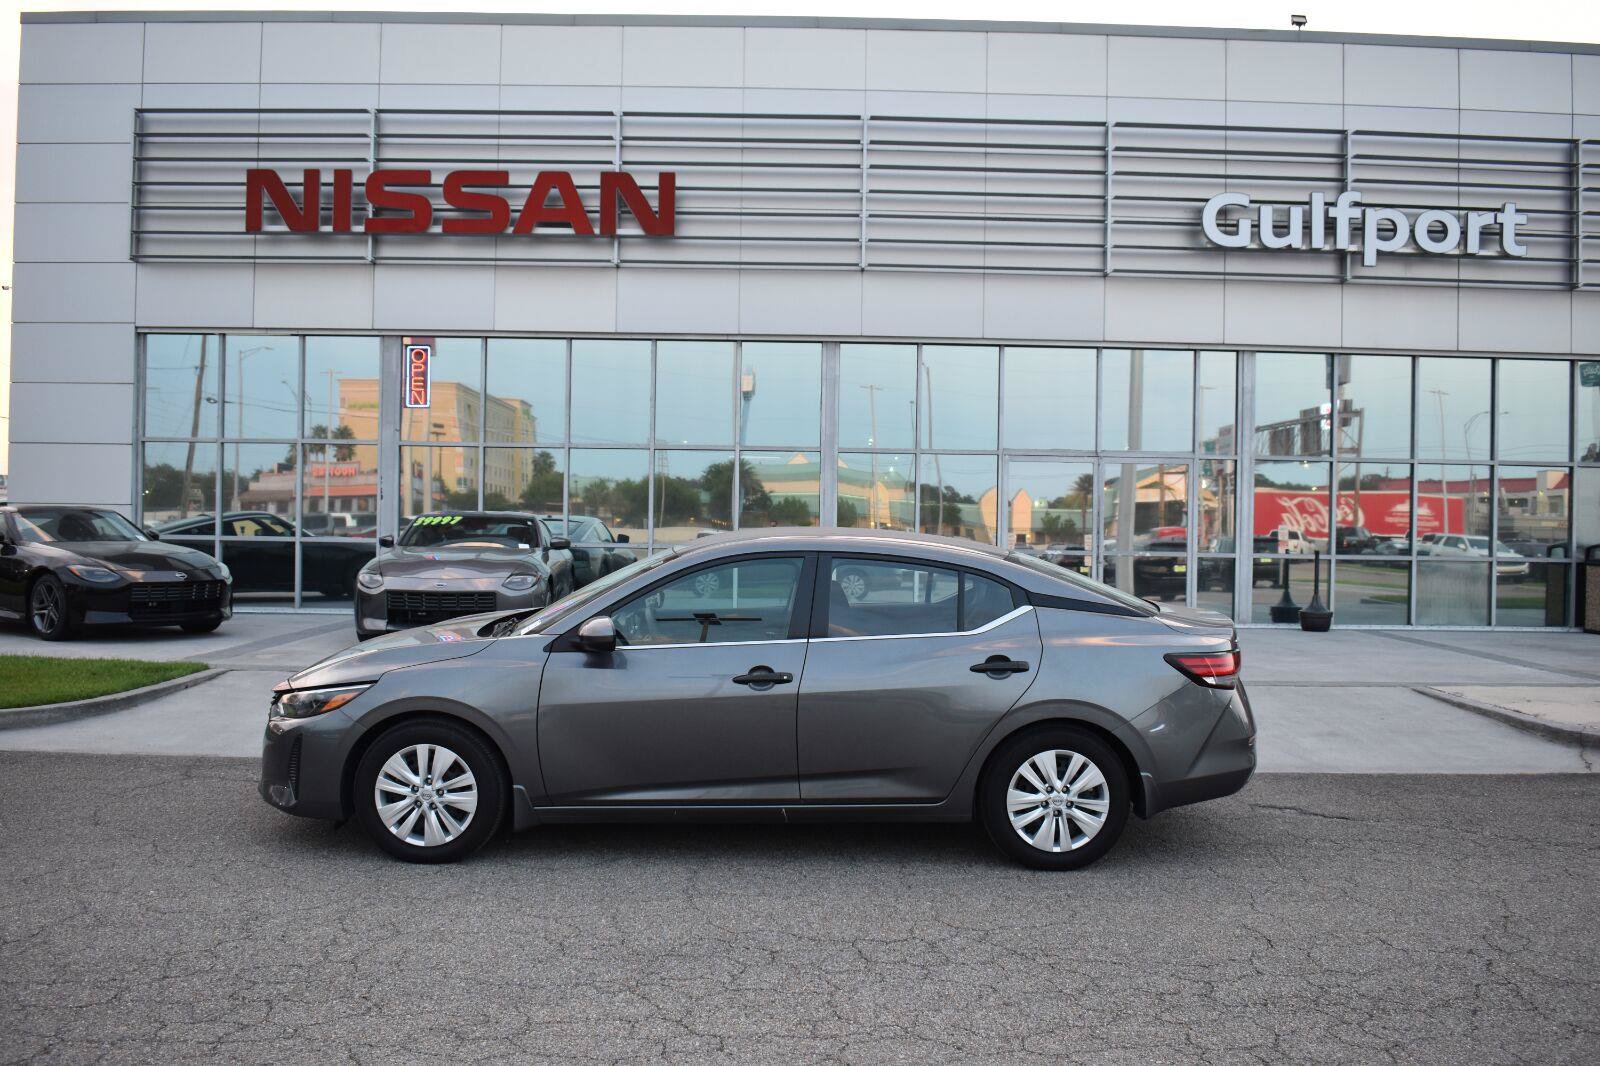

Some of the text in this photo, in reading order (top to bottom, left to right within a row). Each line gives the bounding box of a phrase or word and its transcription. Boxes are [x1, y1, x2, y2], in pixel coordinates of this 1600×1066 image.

[245, 168, 676, 237] NISSAN
[1202, 191, 1528, 267] Gulfport
[411, 348, 426, 405] OPEN
